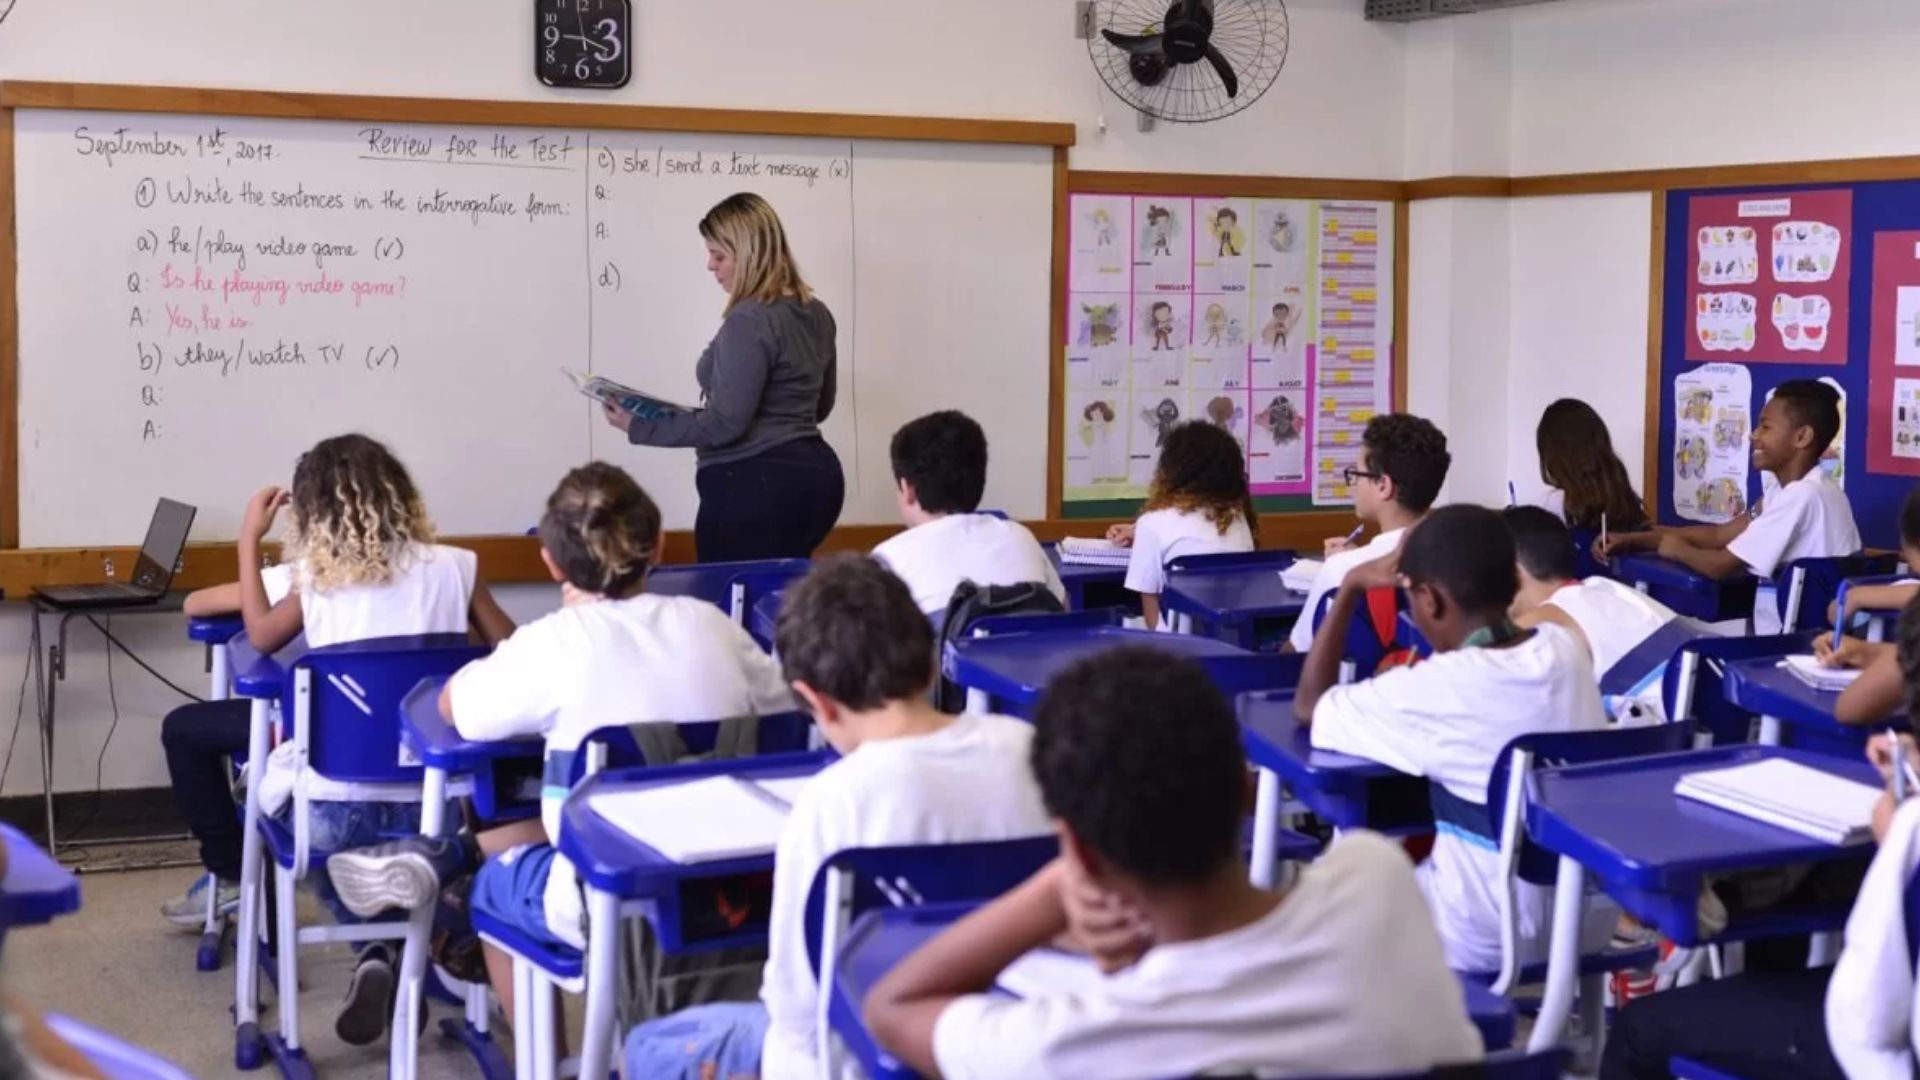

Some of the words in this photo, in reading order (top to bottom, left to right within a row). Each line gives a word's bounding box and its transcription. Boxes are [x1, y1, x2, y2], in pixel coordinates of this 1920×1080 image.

[544, 13, 557, 23] 10
[544, 26, 560, 48] 9
[593, 18, 622, 62] 3
[545, 49, 556, 63] 8
[560, 64, 568, 74] 7
[575, 57, 590, 80] 6
[595, 65, 602, 76] 5
[75, 126, 187, 167] September
[358, 128, 432, 156] Review
[492, 133, 518, 159] the
[529, 136, 573, 162] Test
[711, 159, 722, 173] a
[729, 151, 760, 177] text
[767, 162, 819, 187] message
[167, 176, 234, 204] Write
[239, 181, 266, 207] the
[272, 181, 343, 209] sentences
[354, 196, 373, 209] in
[382, 190, 406, 211] the
[418, 189, 516, 225] interrogative
[525, 192, 570, 224] form:
[595, 184, 610, 200] Q:
[595, 222, 609, 239] A:
[137, 229, 158, 258] a)
[257, 236, 305, 257] video
[311, 243, 359, 269] game
[128, 272, 149, 293] Q:
[161, 263, 184, 289] Is
[191, 266, 215, 293] he
[222, 268, 290, 306] playing
[297, 271, 343, 294] video
[352, 276, 406, 307] game?
[598, 262, 620, 291] d)
[129, 306, 150, 327] A:
[166, 304, 199, 335] Yes,
[201, 304, 221, 330] he
[137, 341, 162, 375] b)
[318, 343, 344, 363] TV
[142, 385, 163, 406] Q:
[143, 420, 162, 441] A:
